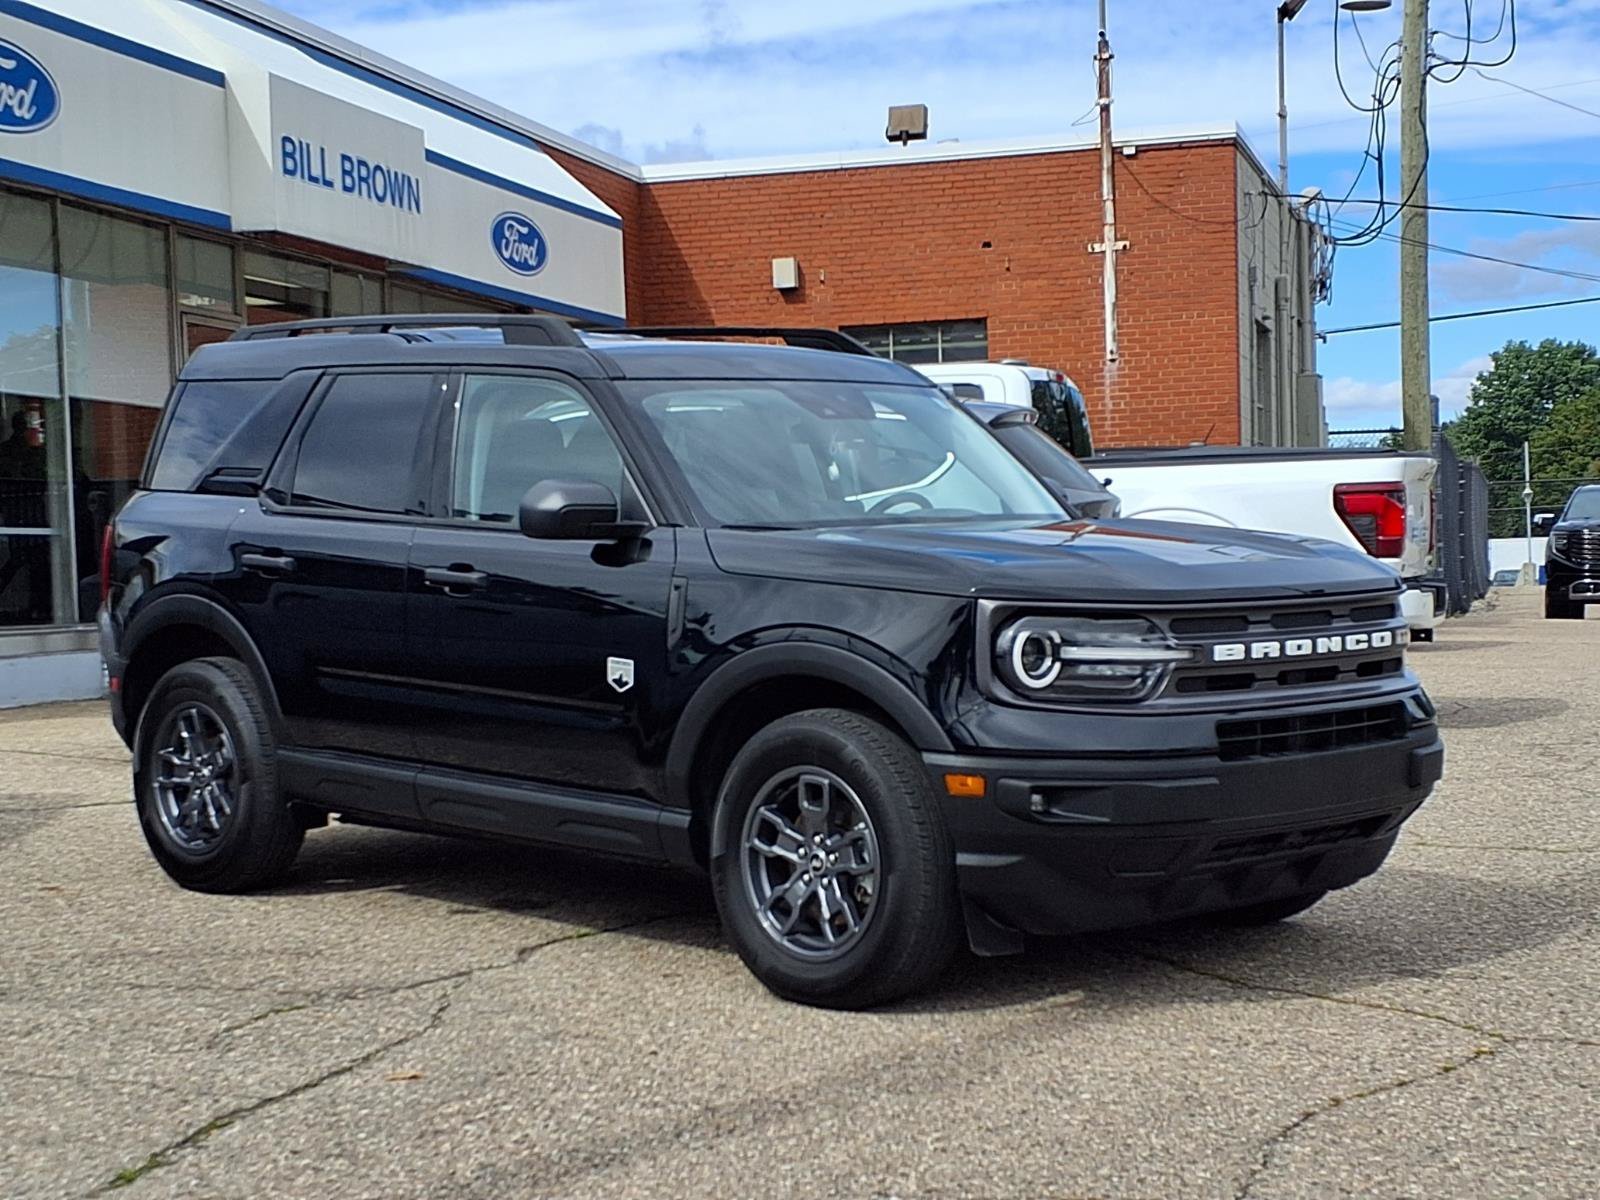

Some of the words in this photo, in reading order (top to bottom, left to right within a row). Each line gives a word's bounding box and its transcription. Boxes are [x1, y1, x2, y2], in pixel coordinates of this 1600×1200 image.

[281, 135, 334, 189] BILL
[340, 152, 421, 214] BROWN
[501, 219, 539, 267] Ford
[1213, 630, 1393, 662] BRONCO
